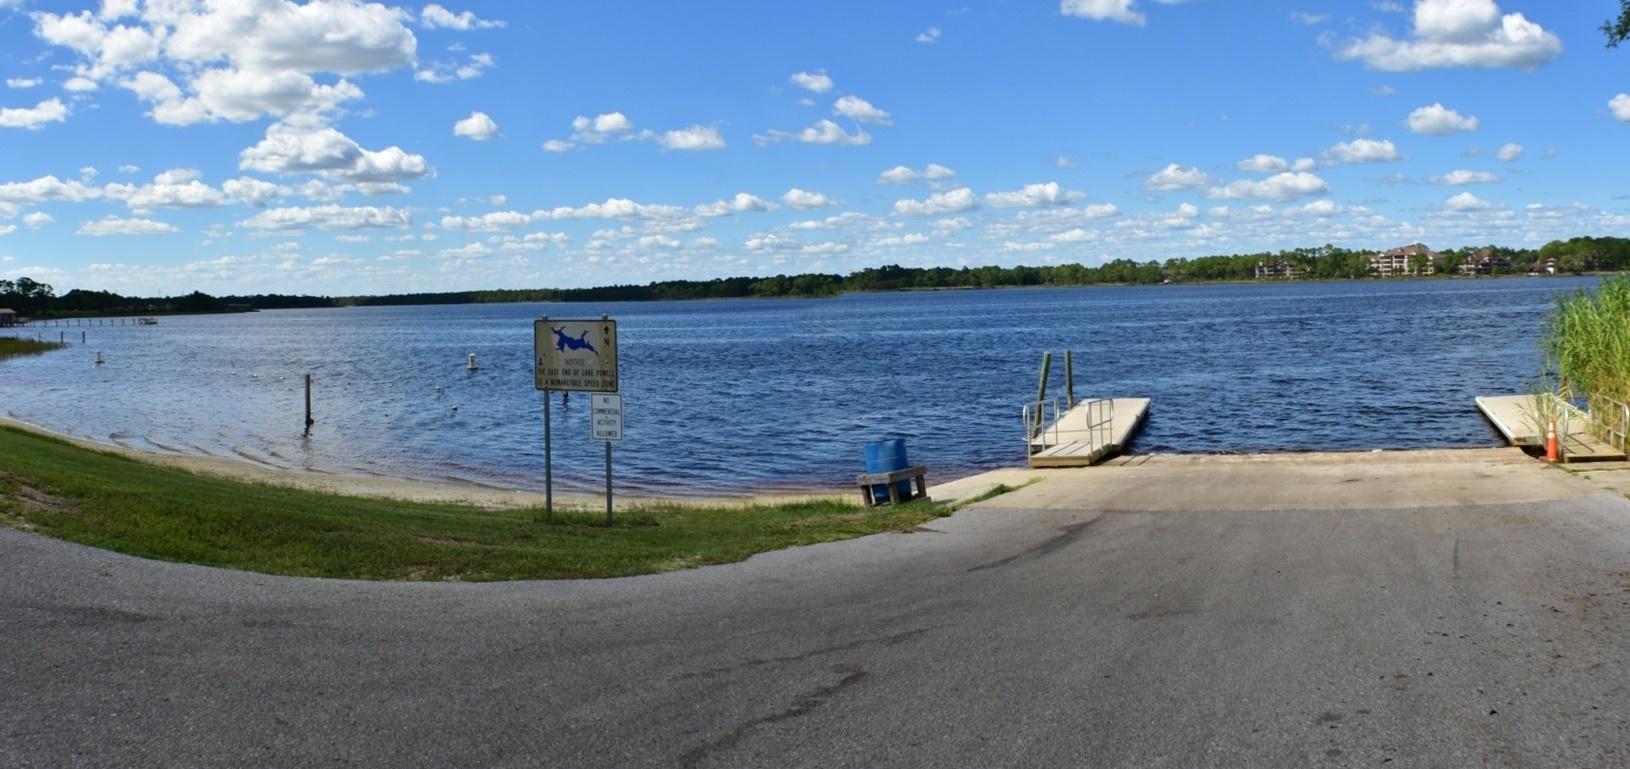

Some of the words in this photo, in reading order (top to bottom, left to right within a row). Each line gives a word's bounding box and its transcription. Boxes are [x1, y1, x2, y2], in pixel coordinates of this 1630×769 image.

[565, 358, 586, 366] NOTICE
[562, 368, 571, 376] END
[582, 369, 594, 377] LAKE
[593, 408, 620, 416] COMMERCIAL
[596, 430, 618, 438] ALLOWED
